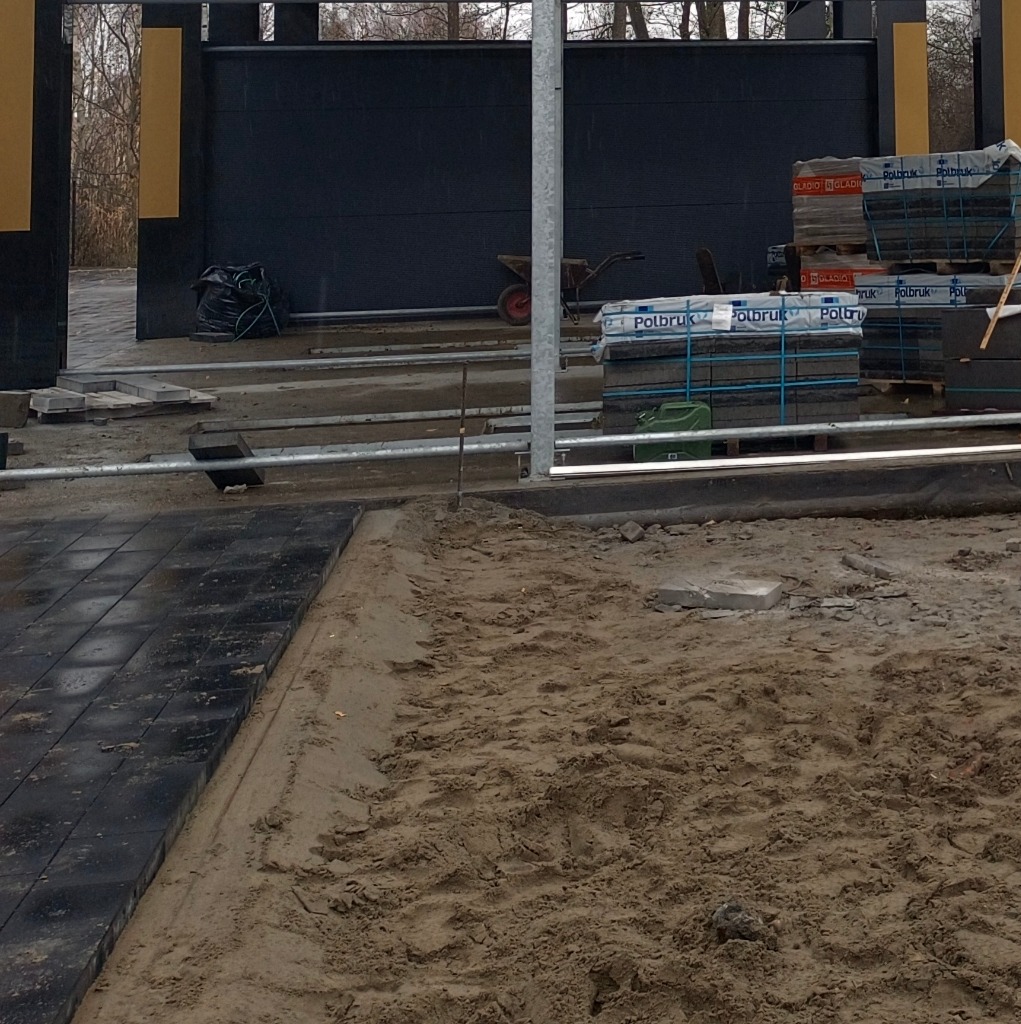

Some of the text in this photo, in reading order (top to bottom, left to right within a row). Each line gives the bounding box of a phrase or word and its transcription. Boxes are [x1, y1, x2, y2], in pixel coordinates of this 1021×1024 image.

[883, 168, 918, 181] Polbruk
[936, 166, 973, 178] Polbruk
[793, 181, 820, 191] GLADIO
[894, 286, 931, 298] Polbruk
[634, 314, 697, 329] Polbruk
